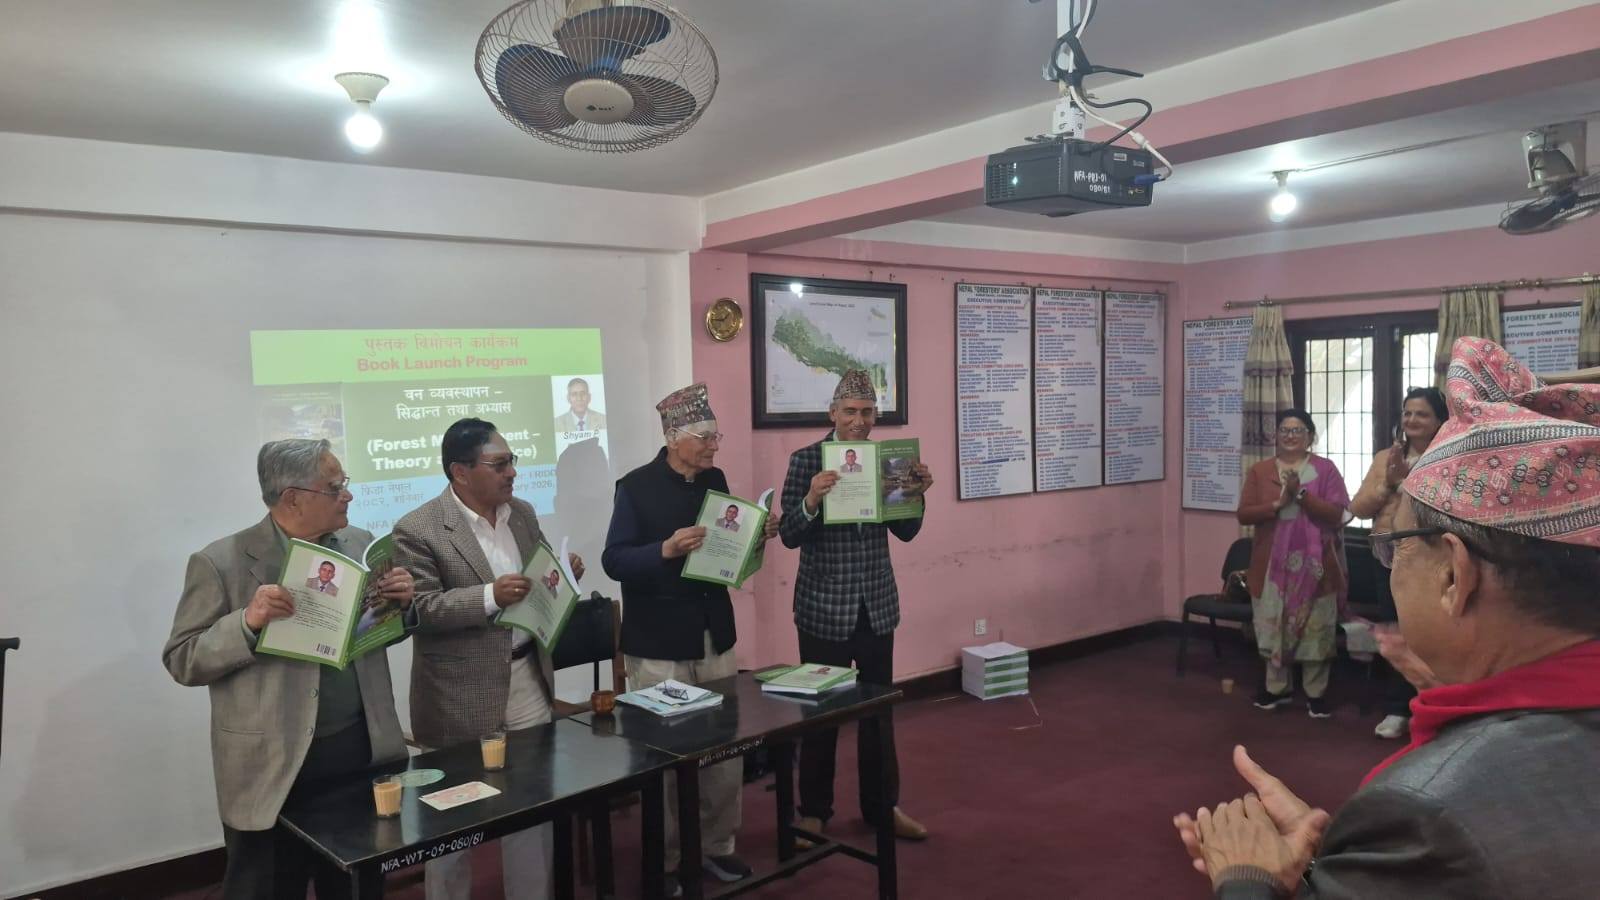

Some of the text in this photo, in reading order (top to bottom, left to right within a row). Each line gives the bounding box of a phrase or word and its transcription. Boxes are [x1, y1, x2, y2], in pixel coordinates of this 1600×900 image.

[959, 285, 973, 293] NEPAL
[357, 354, 528, 372] Book Launch Program
[403, 389, 425, 402] वन
[428, 385, 490, 401] व्यवस्थापन
[395, 401, 513, 420] सिद्धान्त तथा अभ्यास
[563, 430, 592, 442] Shyam
[366, 437, 427, 456] (Forest
[371, 455, 432, 471] Theory
